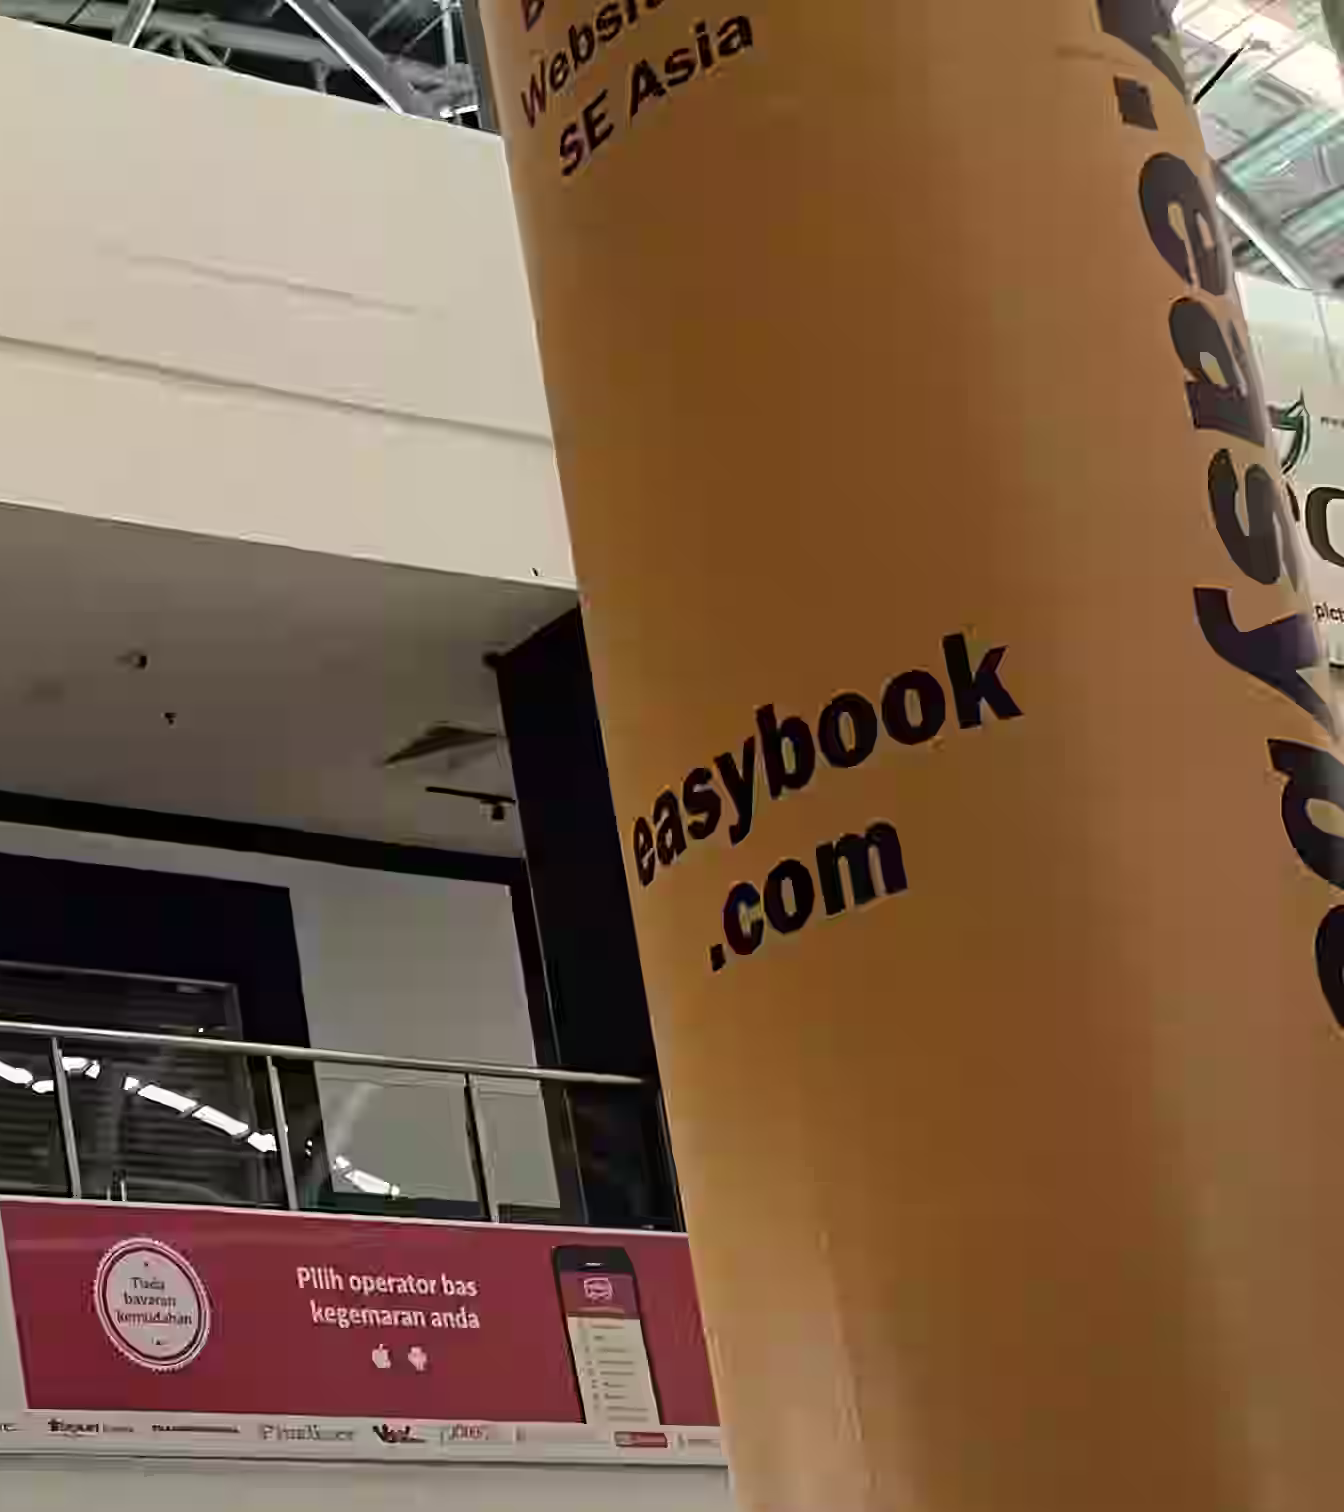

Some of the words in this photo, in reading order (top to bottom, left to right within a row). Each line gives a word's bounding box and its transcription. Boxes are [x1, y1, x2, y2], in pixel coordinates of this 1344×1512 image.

[521, 0, 662, 128] Websi
[559, 90, 613, 177] SE
[628, 15, 753, 119] Asia
[632, 635, 1024, 886] easybook
[711, 821, 910, 971] .com
[116, 1309, 193, 1325] kemudahan
[310, 1301, 425, 1330] kegemaran
[431, 1306, 481, 1330] anda
[349, 1273, 437, 1298] operator
[442, 1276, 478, 1298] bas
